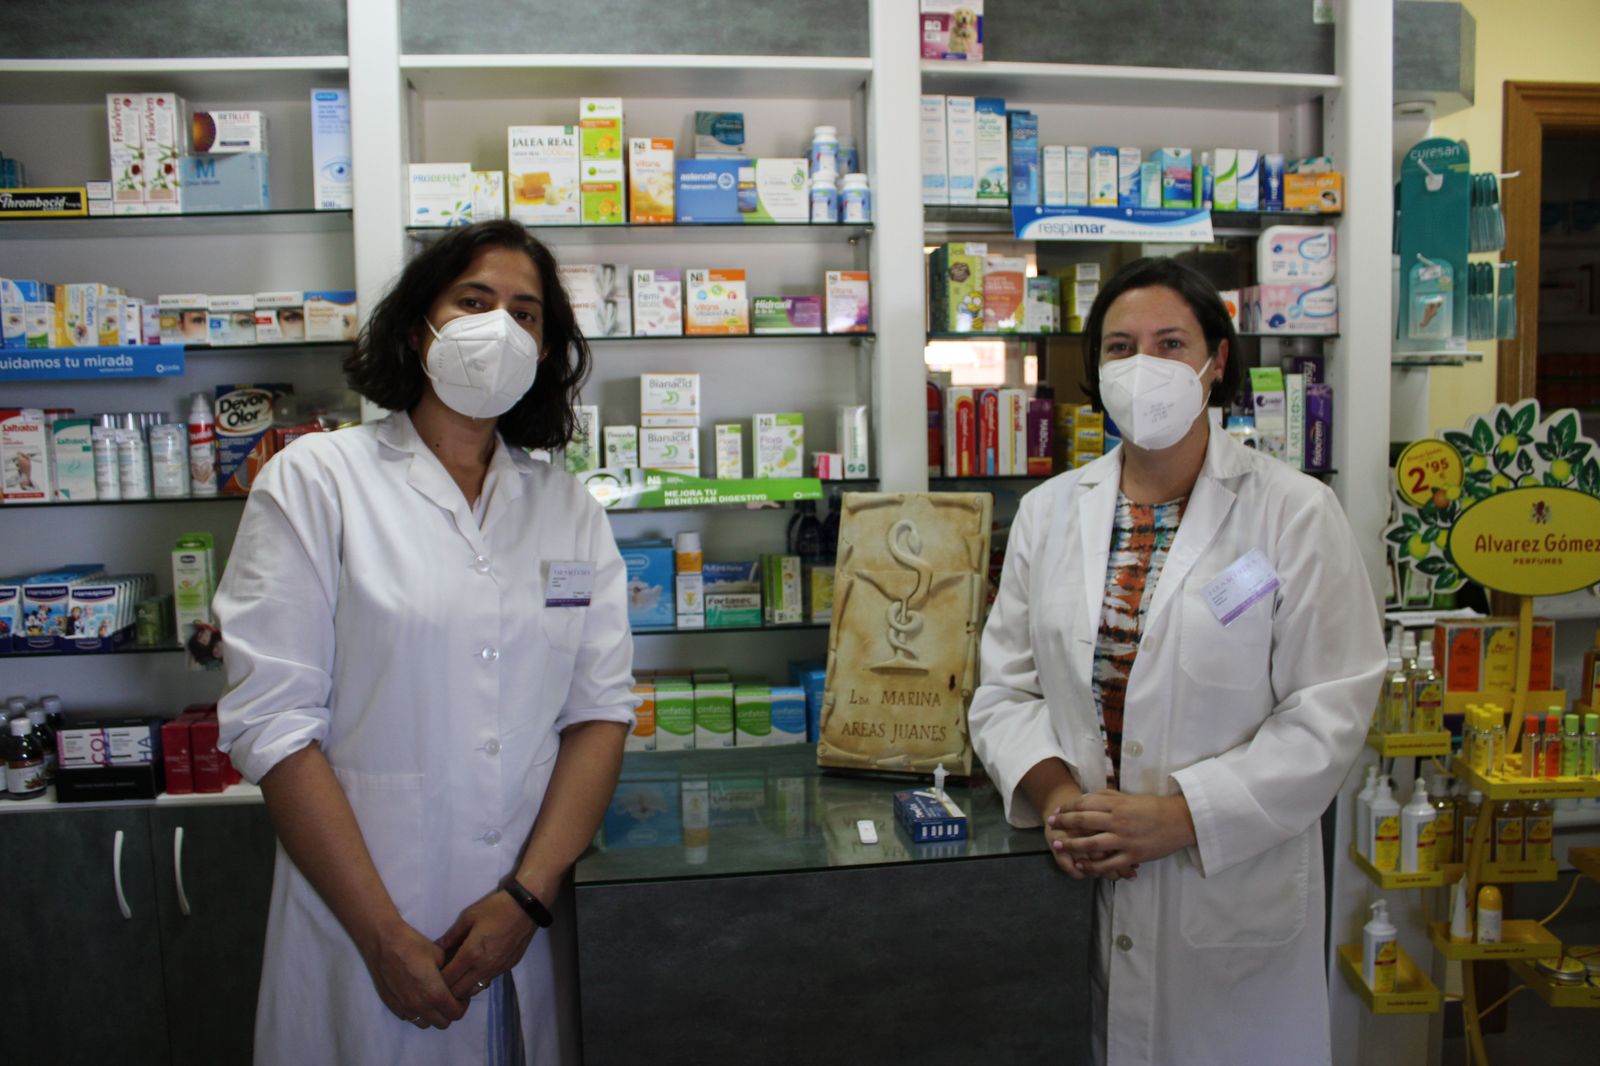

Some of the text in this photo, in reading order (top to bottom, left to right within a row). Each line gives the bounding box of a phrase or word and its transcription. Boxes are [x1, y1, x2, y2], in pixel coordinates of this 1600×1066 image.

[112, 96, 123, 143] FisioVen
[145, 96, 156, 143] FisioVen
[512, 136, 574, 148] JALEA REAL
[1410, 144, 1460, 162] curesan
[0, 193, 66, 210] Thrombocid
[1038, 221, 1106, 238] respimar
[755, 299, 792, 310] Hidroxil
[0, 354, 134, 370] uidamos tu mirada
[648, 380, 693, 388] Bianacid
[219, 393, 267, 414] Devor
[226, 409, 260, 427] Olor
[647, 433, 691, 442] Bianacid
[1312, 420, 1323, 467] fisiocrem
[664, 489, 717, 498] MEJORA TU
[664, 494, 768, 506] BIENESTAR DIGESTIVO
[1474, 533, 1600, 553] Alvarez Gómez
[1512, 557, 1563, 565] PERFUMES
[26, 588, 66, 597] Hansaplast
[73, 589, 114, 598] Hansaplast
[707, 596, 752, 606] Fortasec
[880, 690, 942, 708] MARINA
[657, 706, 691, 716] cinfatós
[696, 704, 731, 714] cinfatós
[841, 721, 948, 743] AREAS JUANES
[137, 737, 152, 762] HA
